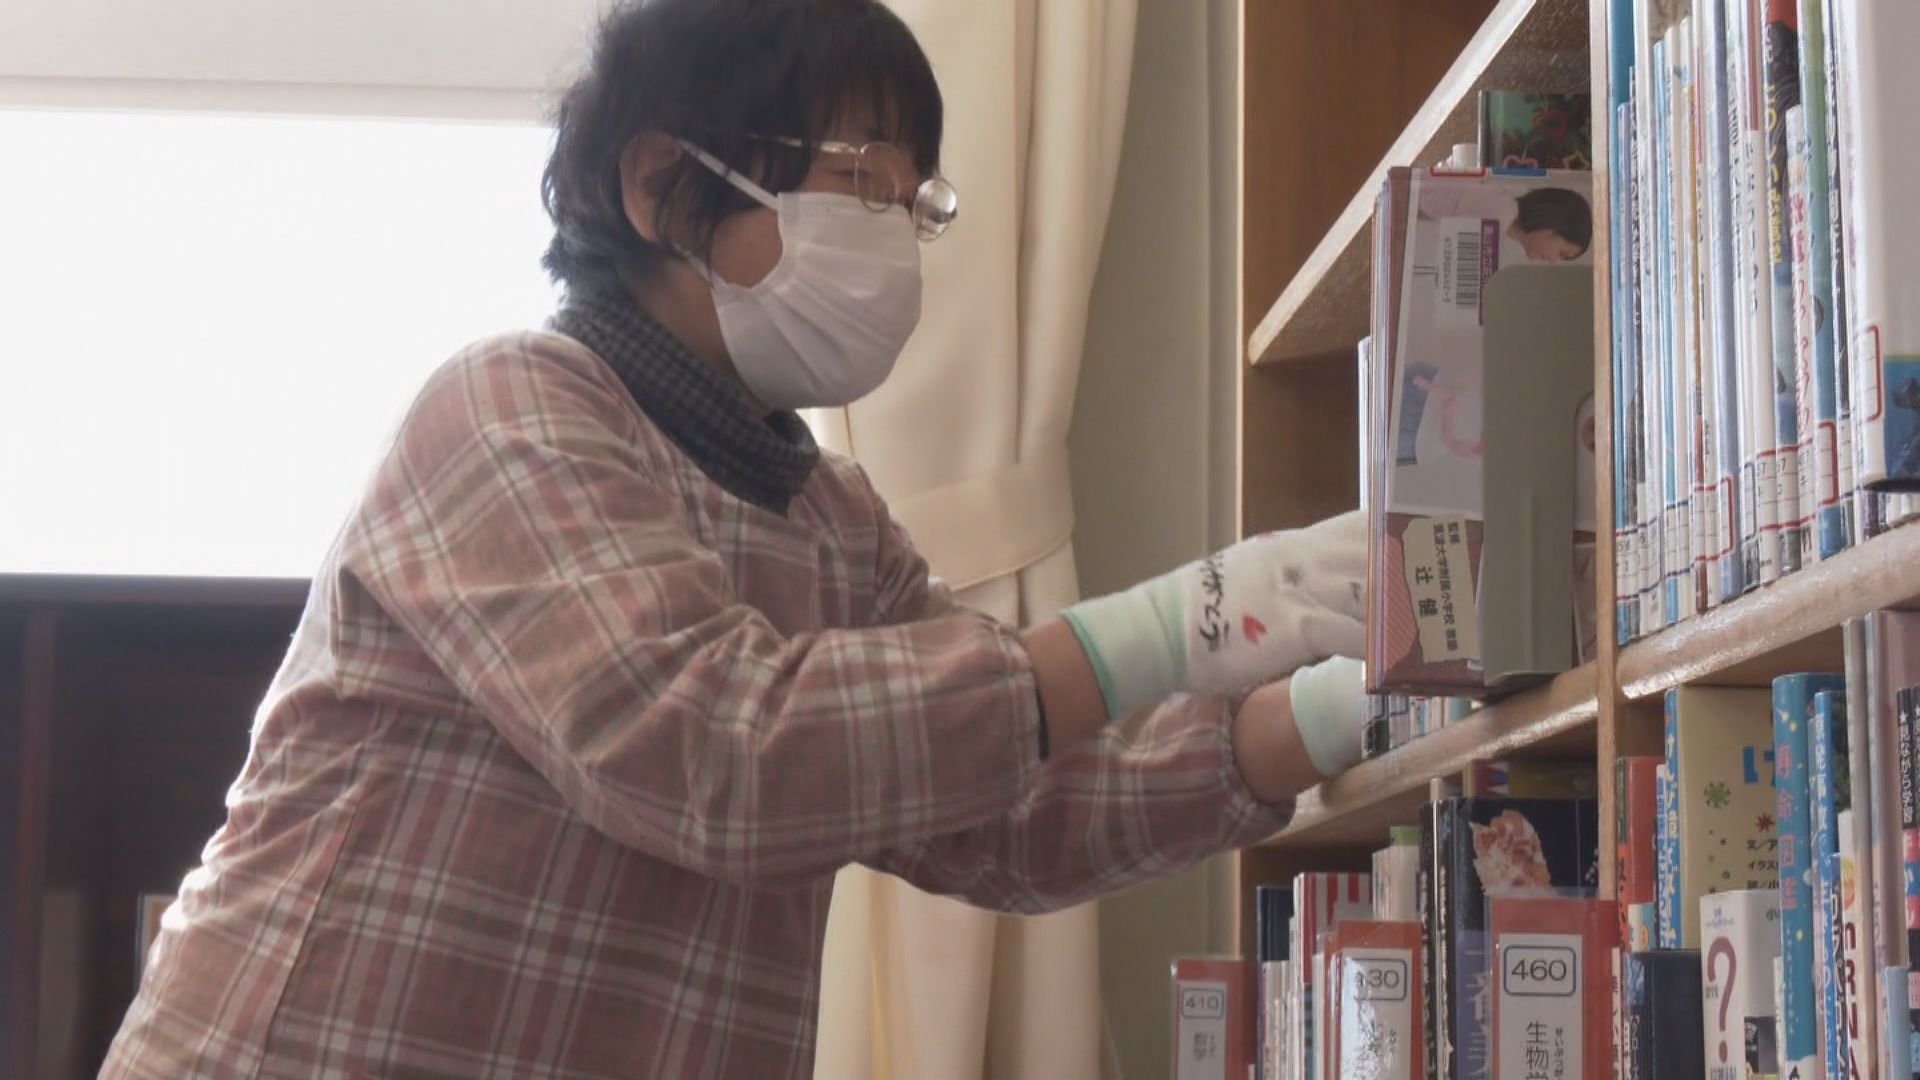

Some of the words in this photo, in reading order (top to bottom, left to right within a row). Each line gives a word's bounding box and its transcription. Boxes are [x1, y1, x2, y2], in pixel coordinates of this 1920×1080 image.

[1415, 565, 1433, 585] 辻
[1511, 957, 1567, 982] 460
[1184, 996, 1219, 1011] 410
[1553, 1027, 1565, 1080] せいぶつが
